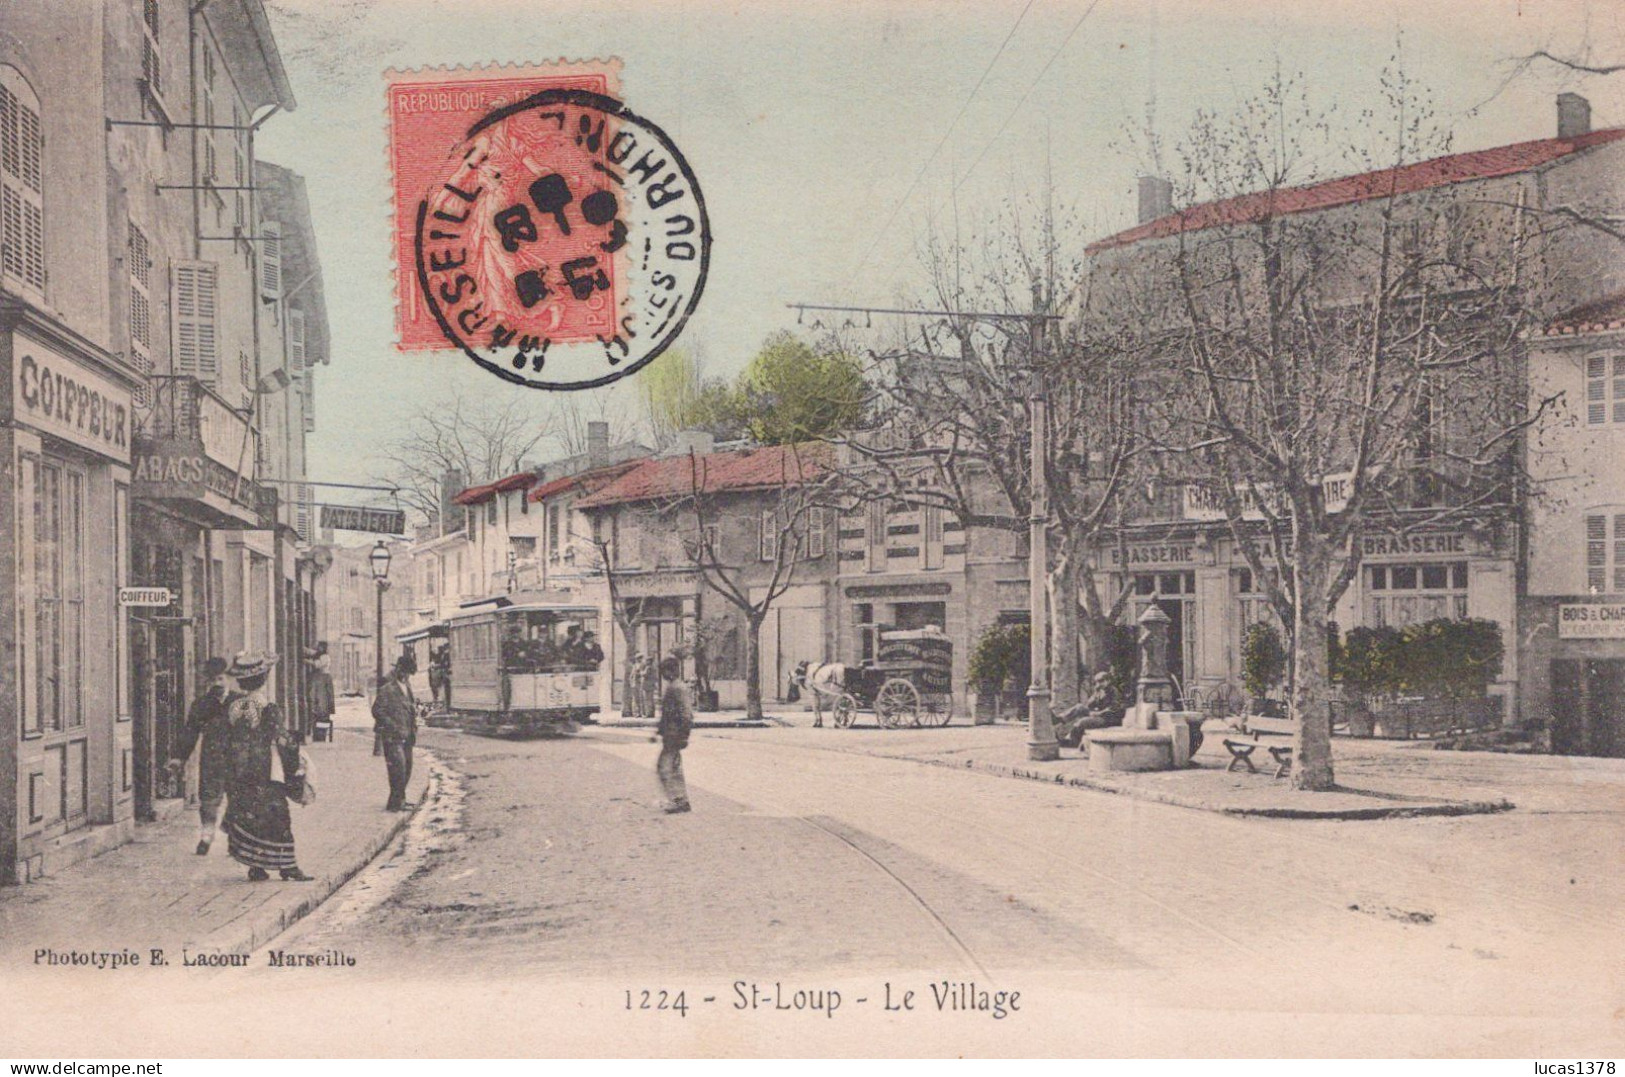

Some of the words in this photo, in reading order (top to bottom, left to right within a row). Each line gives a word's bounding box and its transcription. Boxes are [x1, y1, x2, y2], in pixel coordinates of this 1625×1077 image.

[20, 354, 127, 449] COIFFEUR
[133, 454, 204, 482] ABACS
[1251, 541, 1294, 559] CAE
[1364, 532, 1466, 555] BRASSERIE
[120, 590, 168, 603] COIFFEUR
[1563, 607, 1588, 621] BOIS
